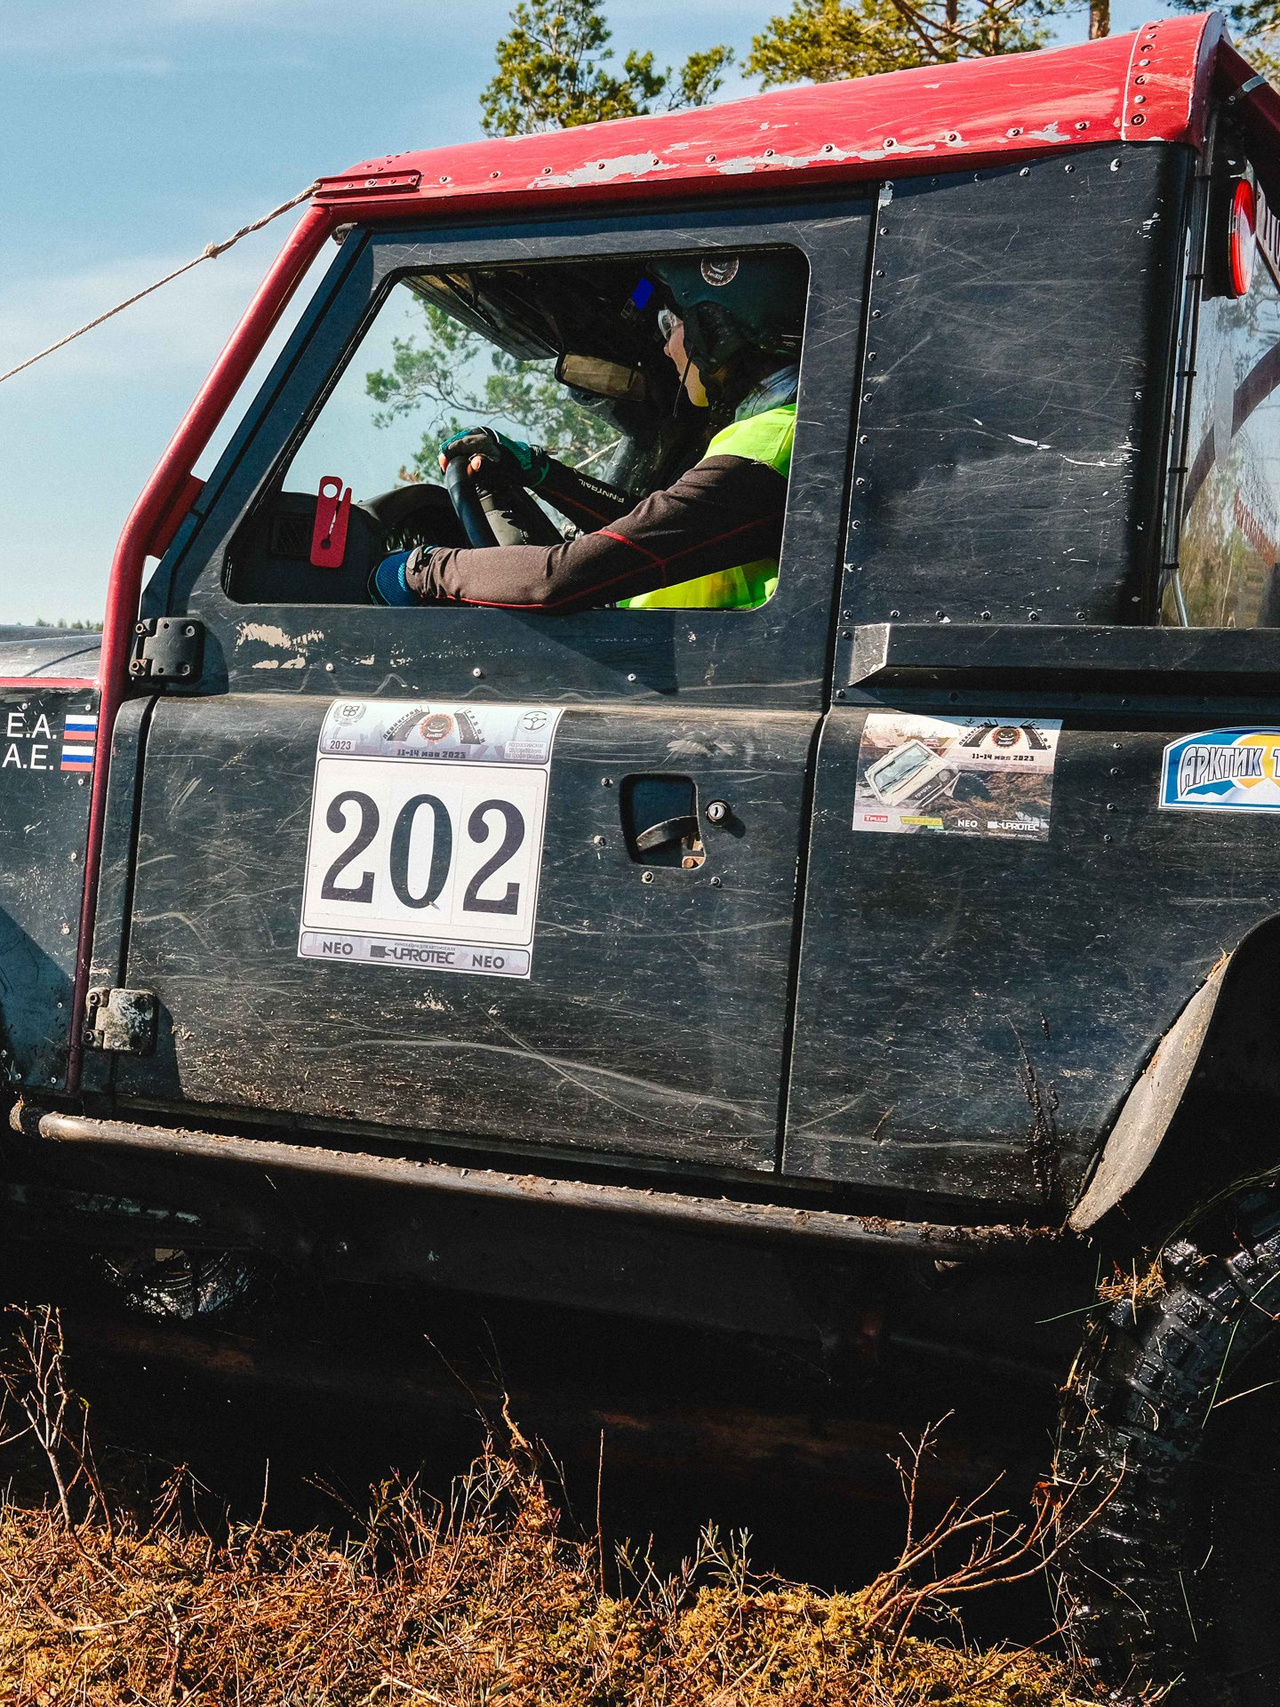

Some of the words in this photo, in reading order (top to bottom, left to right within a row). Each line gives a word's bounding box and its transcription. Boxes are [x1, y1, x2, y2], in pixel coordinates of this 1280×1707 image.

[6, 712, 58, 739] Е.А.
[329, 740, 352, 750] 2023
[1, 744, 54, 771] А.Е.
[397, 749, 420, 757] 11-14
[442, 751, 466, 759] 2023
[1180, 746, 1264, 797] АРКТИК
[957, 819, 978, 828] NEO
[995, 821, 1040, 831] SUPROTEC
[320, 790, 526, 916] 202
[322, 941, 354, 956] NEO
[382, 946, 455, 965] SUPROTEC
[471, 954, 505, 970] NEO
